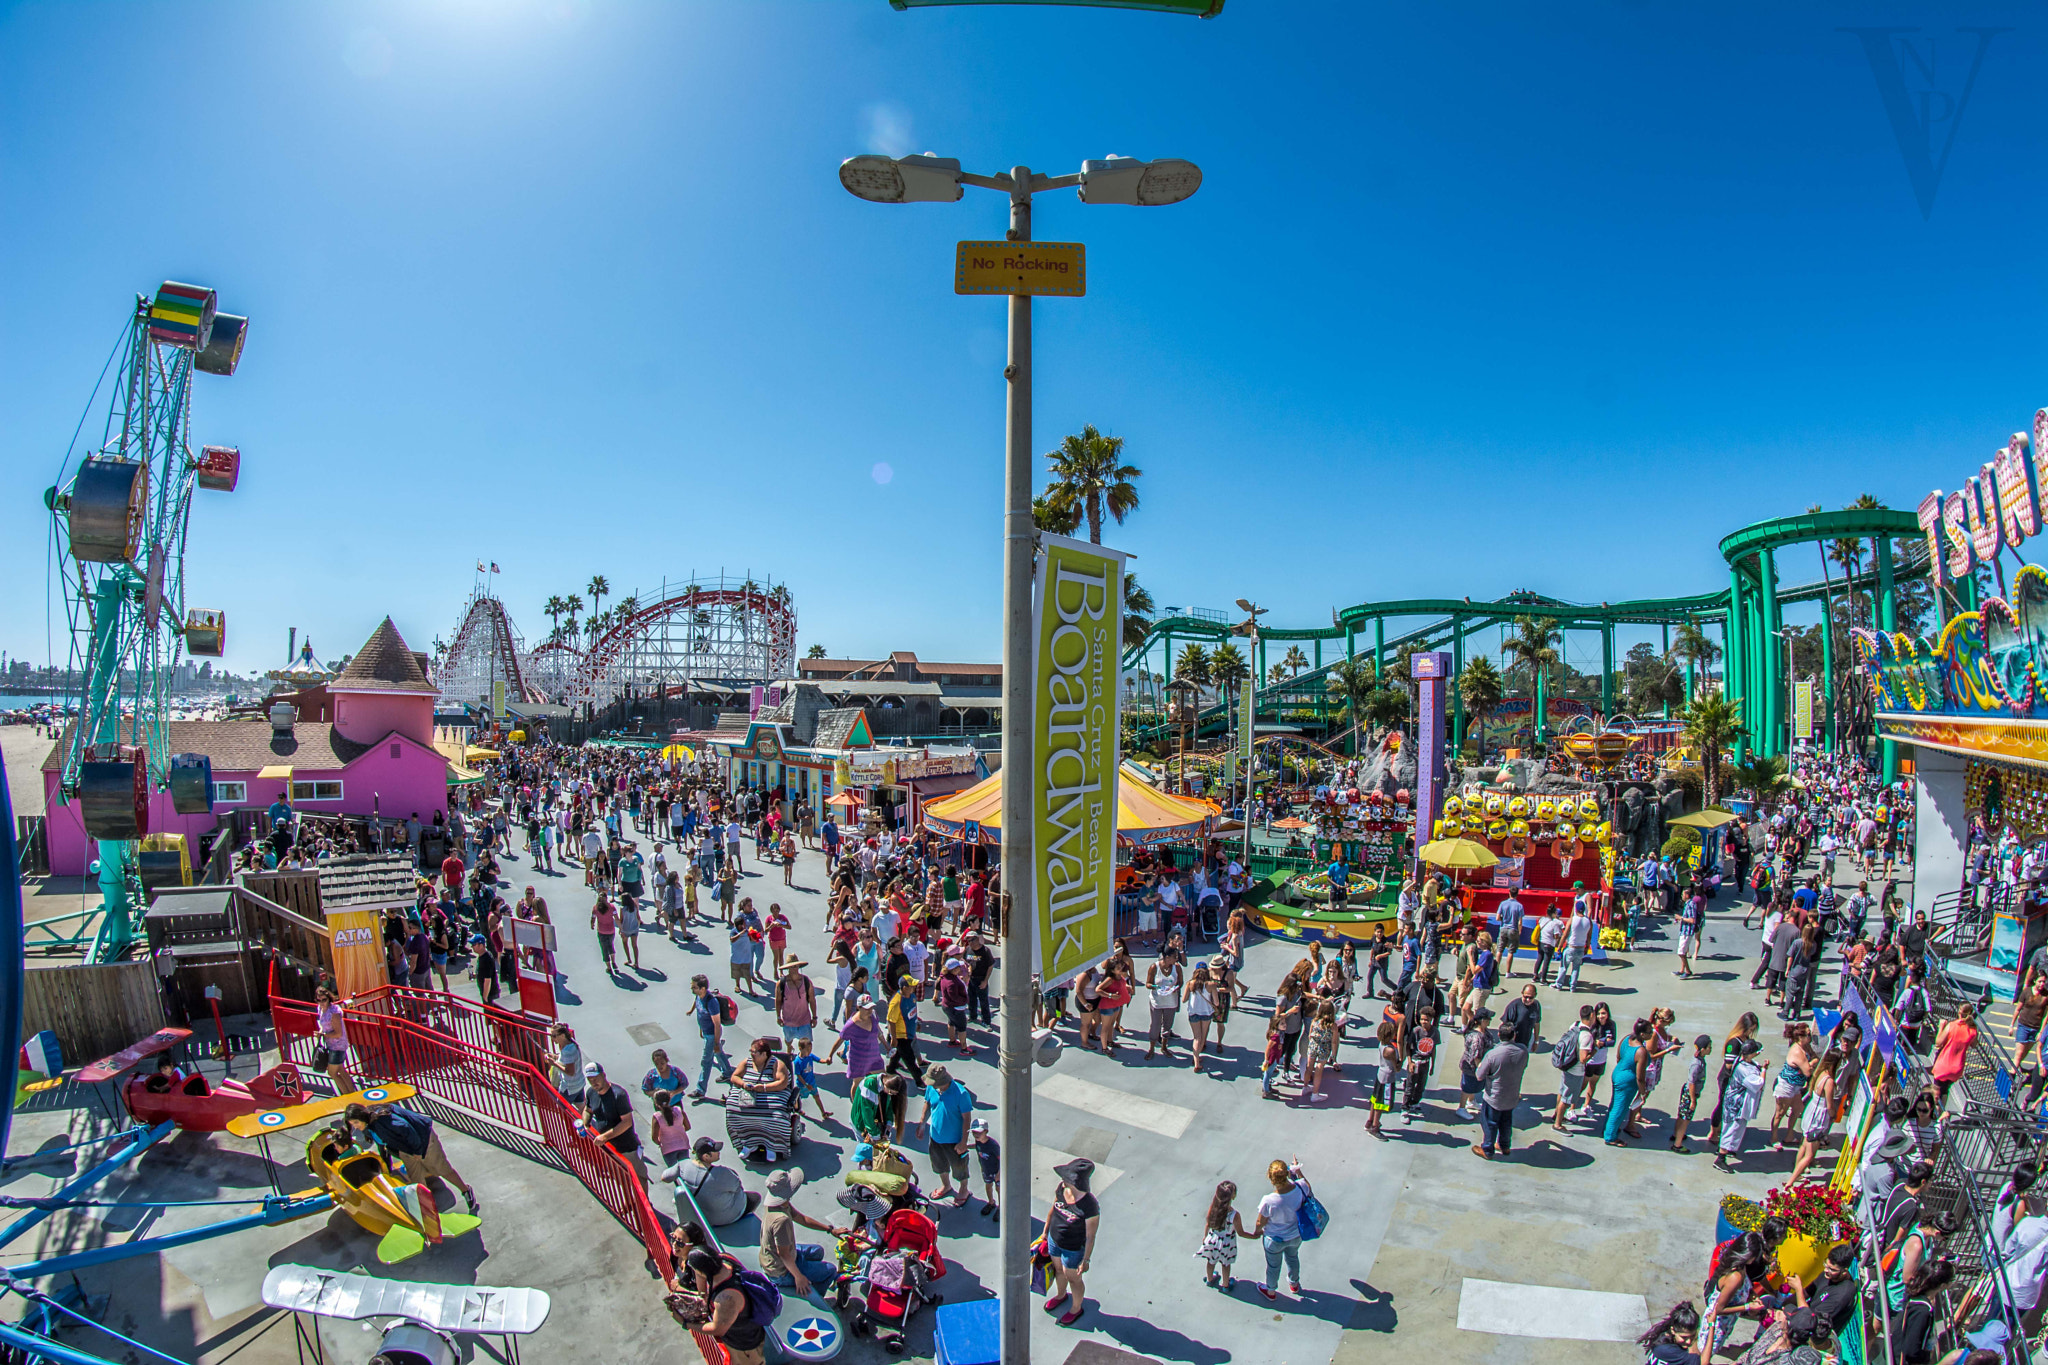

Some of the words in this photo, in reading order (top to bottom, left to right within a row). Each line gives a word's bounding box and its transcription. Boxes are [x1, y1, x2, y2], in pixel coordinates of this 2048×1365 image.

[972, 257, 995, 270] No
[1003, 257, 1069, 274] Rocking
[1091, 627, 1107, 701] Santa
[1489, 699, 1530, 716] RAZY
[1089, 704, 1106, 769] Cruz
[1046, 558, 1107, 974] Boardwalk
[851, 773, 869, 781] KETTLE
[870, 773, 884, 781] CORN
[1088, 801, 1103, 877] Beach
[1141, 828, 1192, 843] Bulgy
[335, 927, 372, 942] ATM
